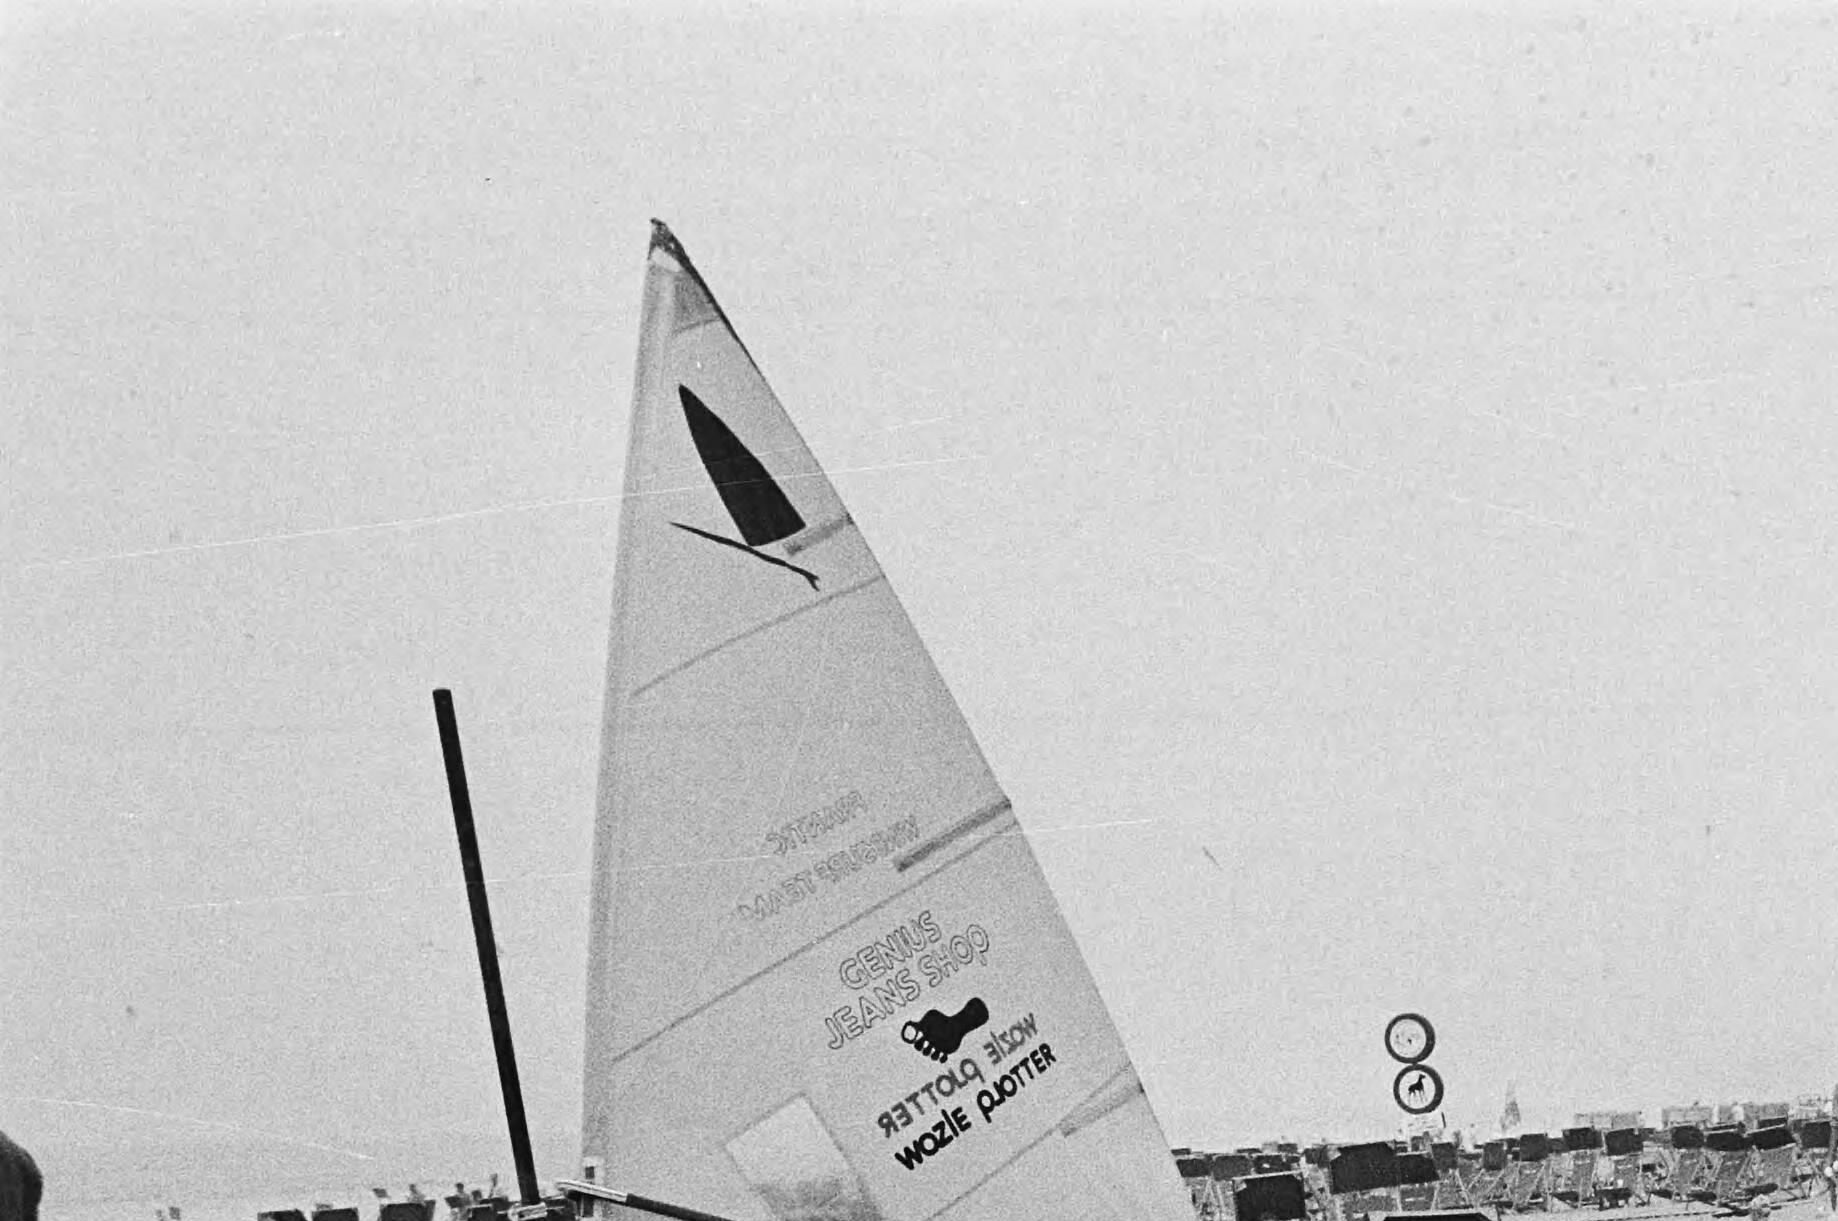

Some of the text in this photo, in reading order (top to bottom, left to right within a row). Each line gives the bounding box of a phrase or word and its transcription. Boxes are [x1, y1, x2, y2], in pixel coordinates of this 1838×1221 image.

[825, 924, 990, 1050] JEANS SHOP
[839, 910, 942, 990] GENIUS
[894, 1106, 972, 1171] WOZIE
